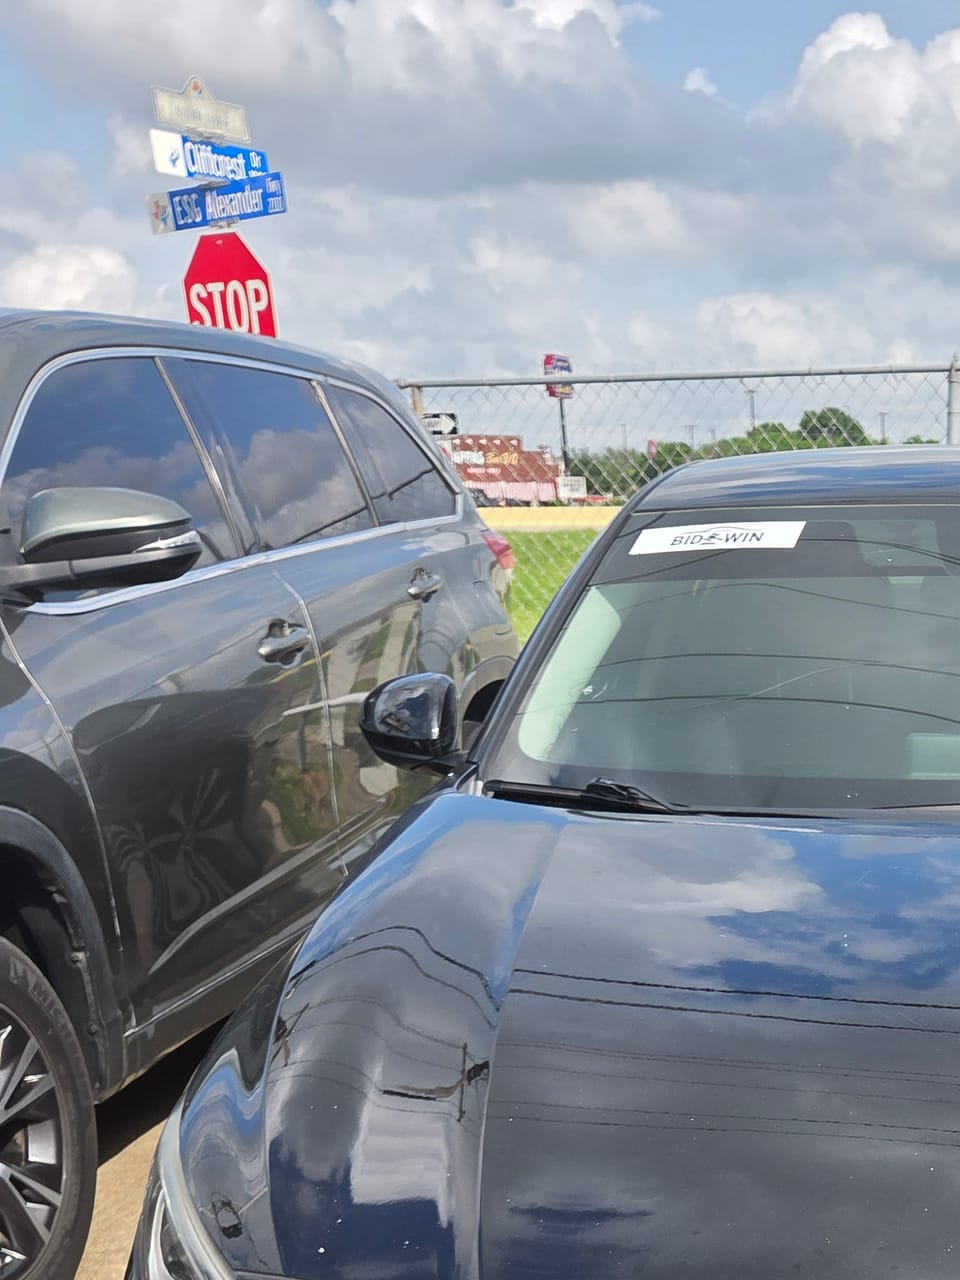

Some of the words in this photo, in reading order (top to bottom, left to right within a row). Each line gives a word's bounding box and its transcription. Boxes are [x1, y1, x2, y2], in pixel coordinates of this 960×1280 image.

[205, 185, 264, 220] Alexander
[189, 278, 269, 334] STOP
[670, 534, 703, 546] BID
[725, 532, 764, 543] WIN
